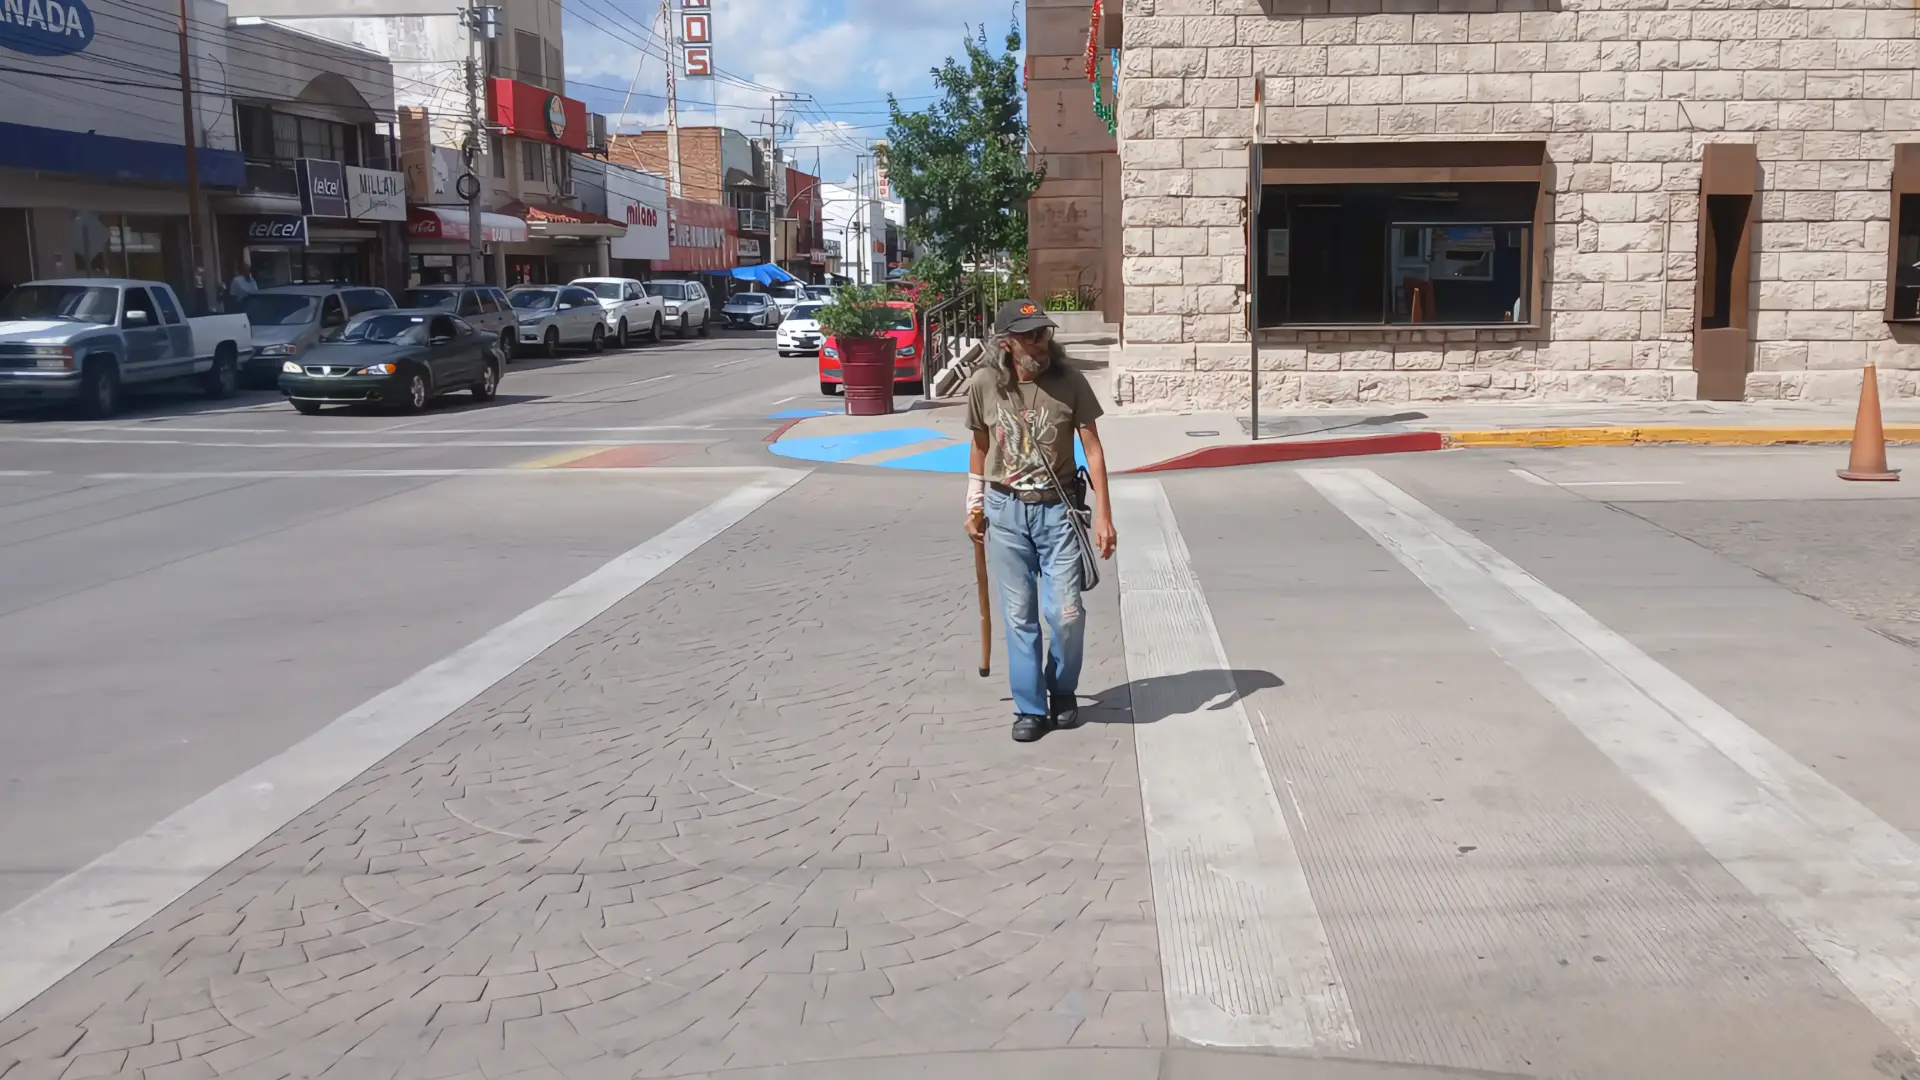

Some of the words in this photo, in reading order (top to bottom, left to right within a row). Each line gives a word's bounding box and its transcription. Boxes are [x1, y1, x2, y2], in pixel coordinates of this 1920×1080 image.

[0, 0, 85, 38] NADA
[314, 177, 340, 196] telcel
[359, 174, 397, 196] MILLAN
[627, 204, 658, 227] milano
[248, 219, 301, 237] telcel
